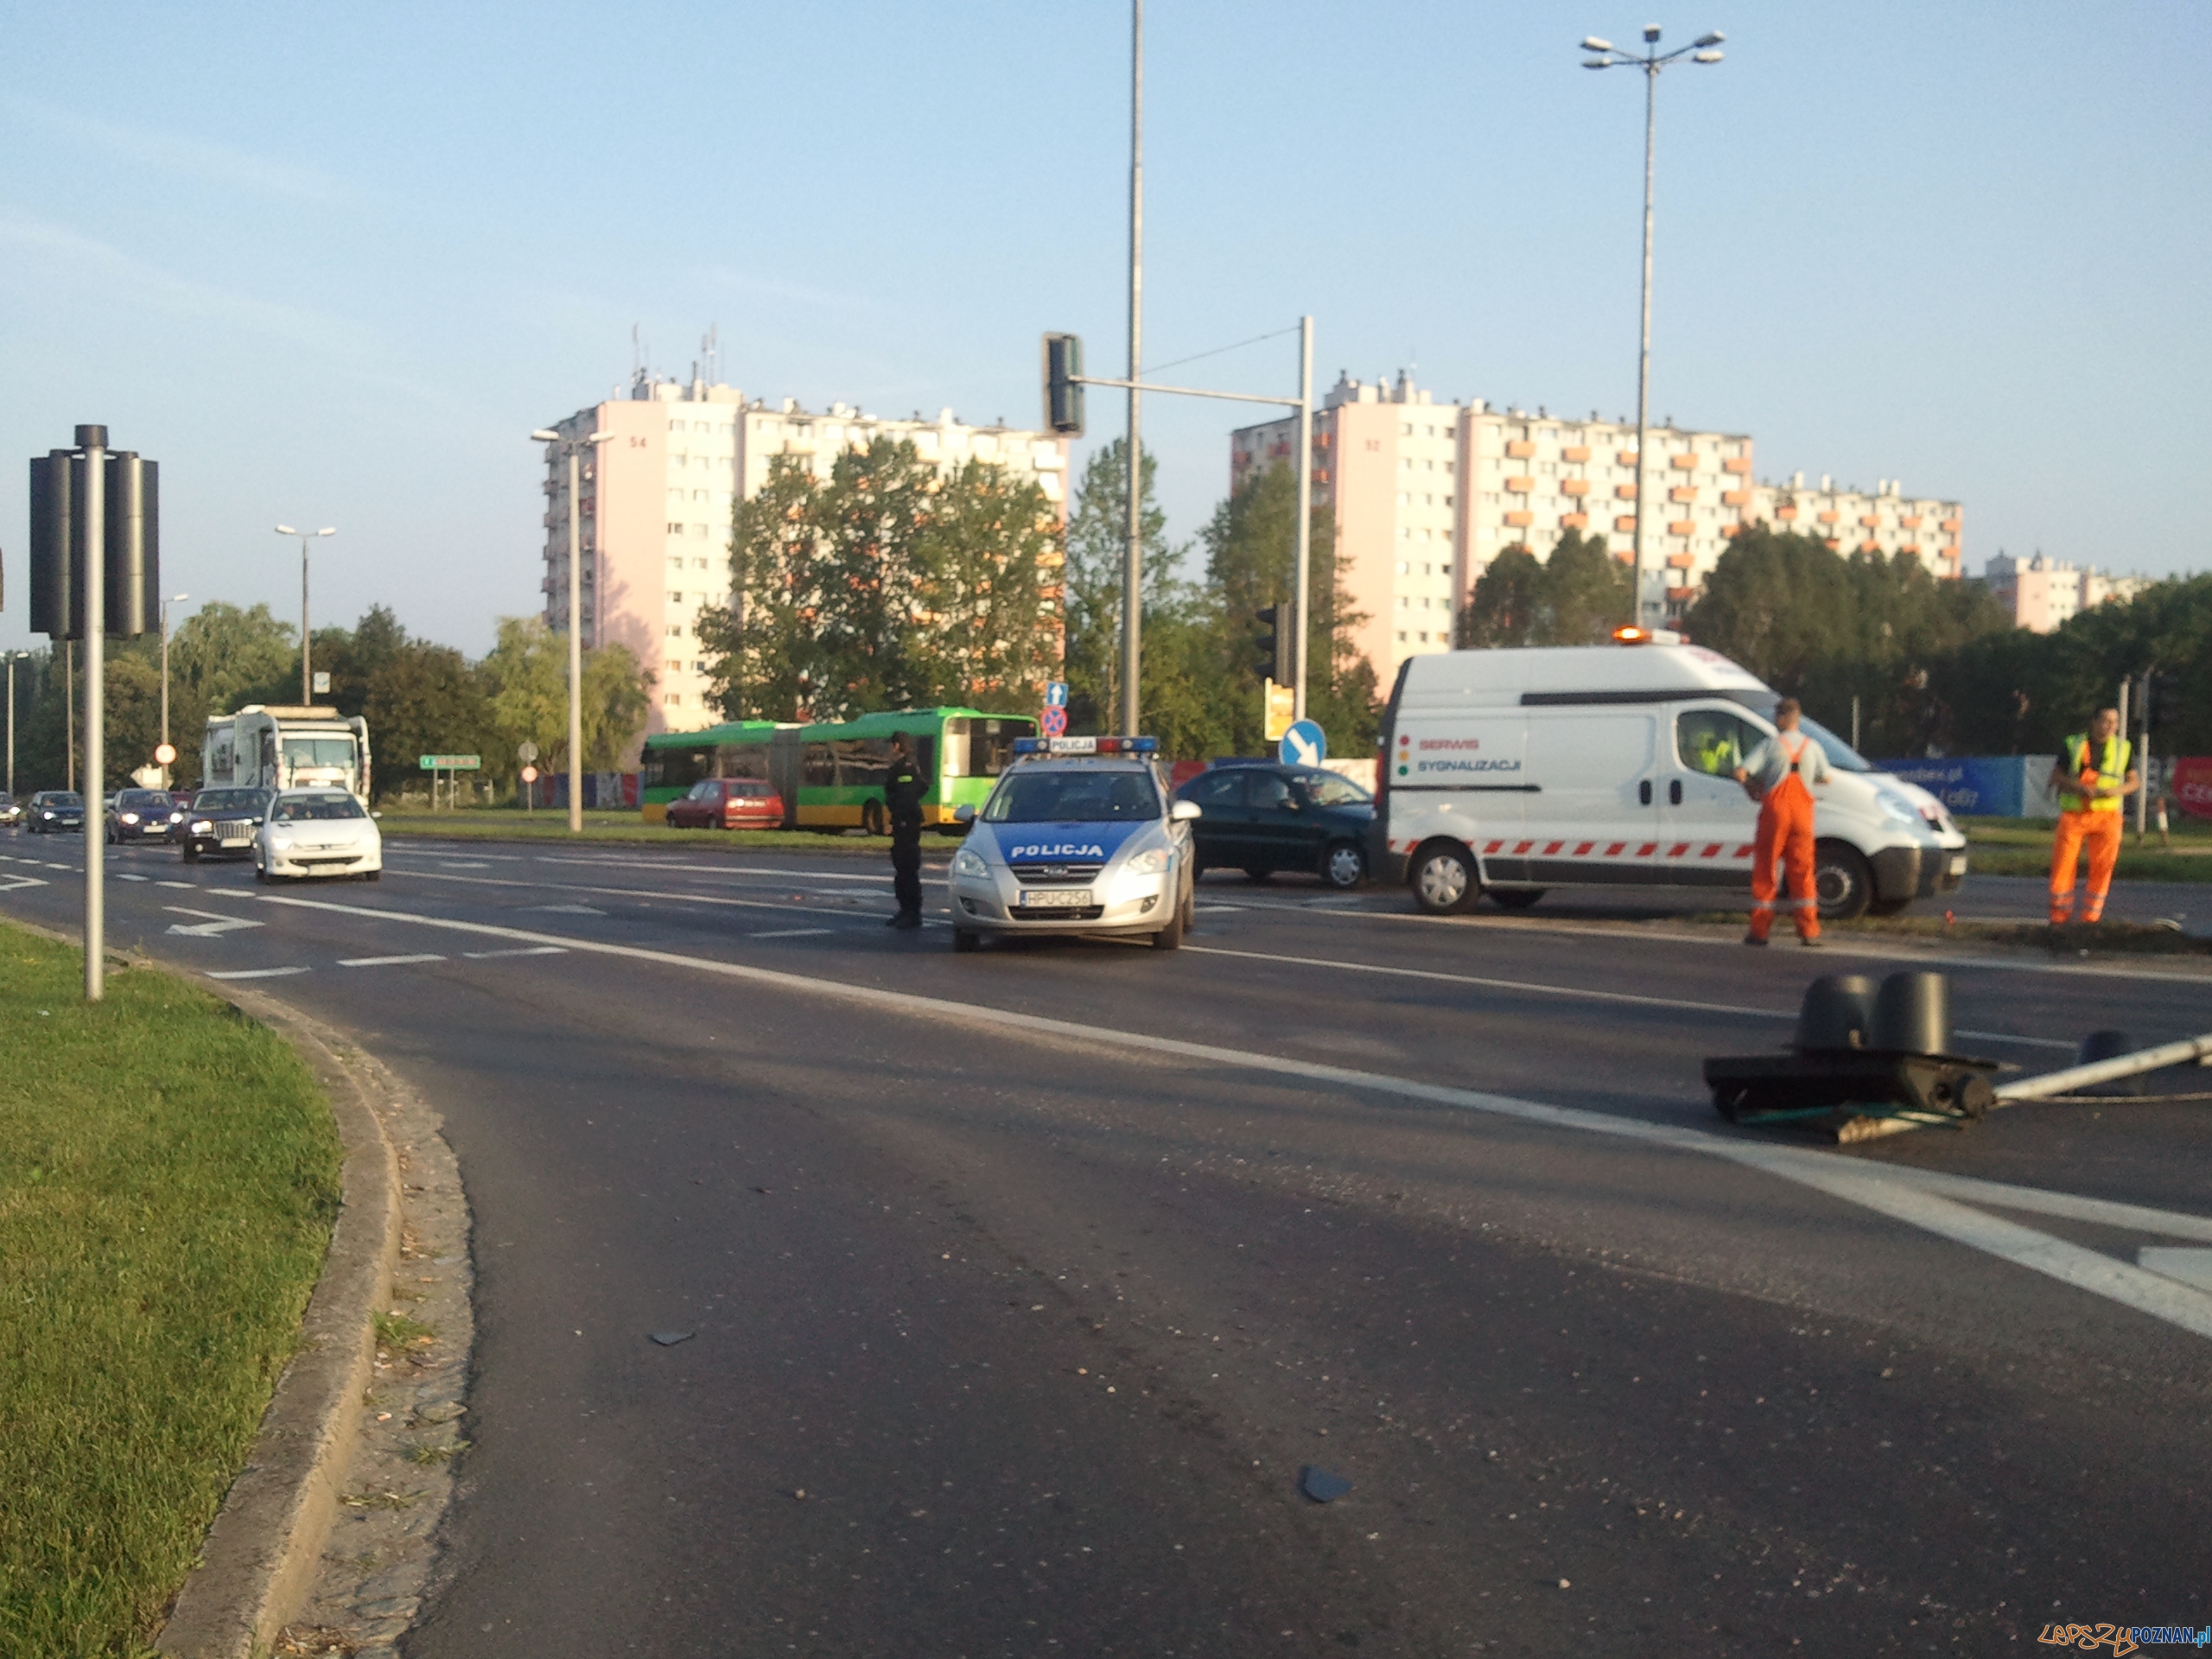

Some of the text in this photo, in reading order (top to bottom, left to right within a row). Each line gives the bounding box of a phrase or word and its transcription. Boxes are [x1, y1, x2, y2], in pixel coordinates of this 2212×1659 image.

[630, 435, 646, 448] 54
[1052, 740, 1094, 751] POLICJA
[1419, 739, 1479, 751] SERWIS
[1417, 760, 1522, 772] SYGNALIZACJI
[1010, 844, 1104, 858] POLICJA
